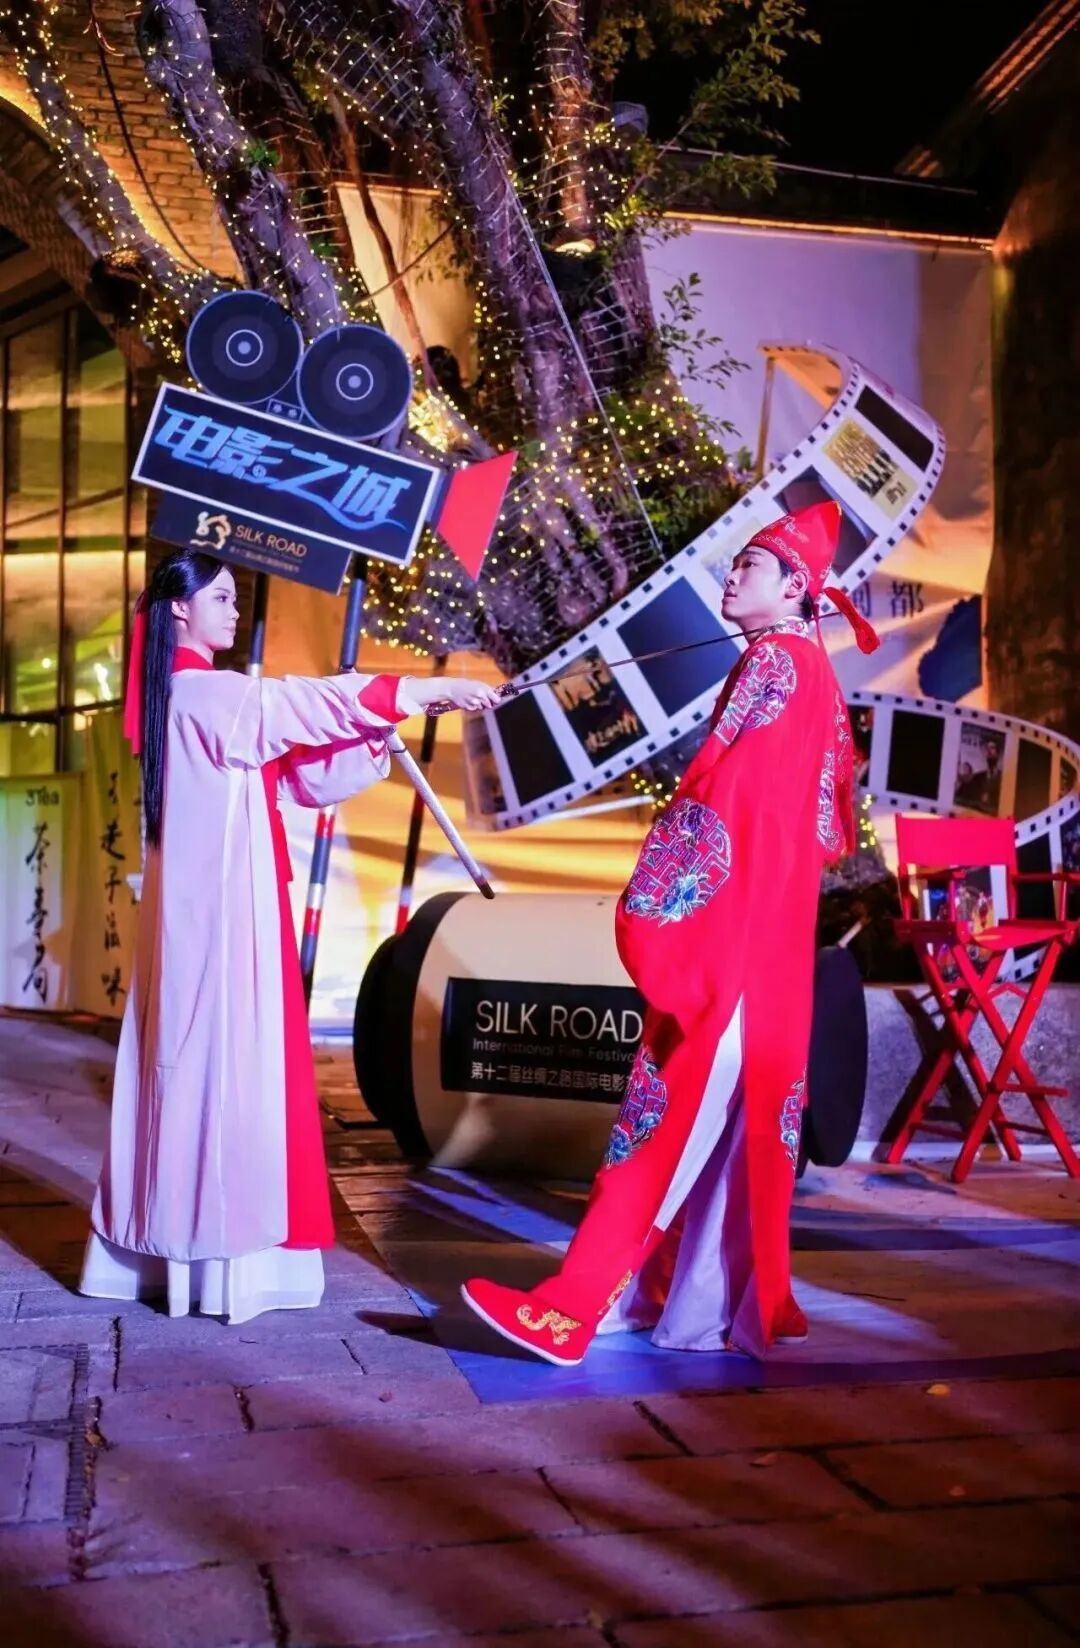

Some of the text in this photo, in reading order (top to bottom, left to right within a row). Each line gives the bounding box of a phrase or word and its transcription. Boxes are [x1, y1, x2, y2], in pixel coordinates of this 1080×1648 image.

[154, 403, 412, 531] 电影之城
[235, 524, 264, 545] SILK
[266, 534, 308, 558] ROAD
[475, 1000, 643, 1043] SILK ROAD
[472, 1037, 554, 1057] International
[588, 1047, 635, 1063] Festiva
[470, 1061, 631, 1093] 第十二届丝绸之路国际电影
